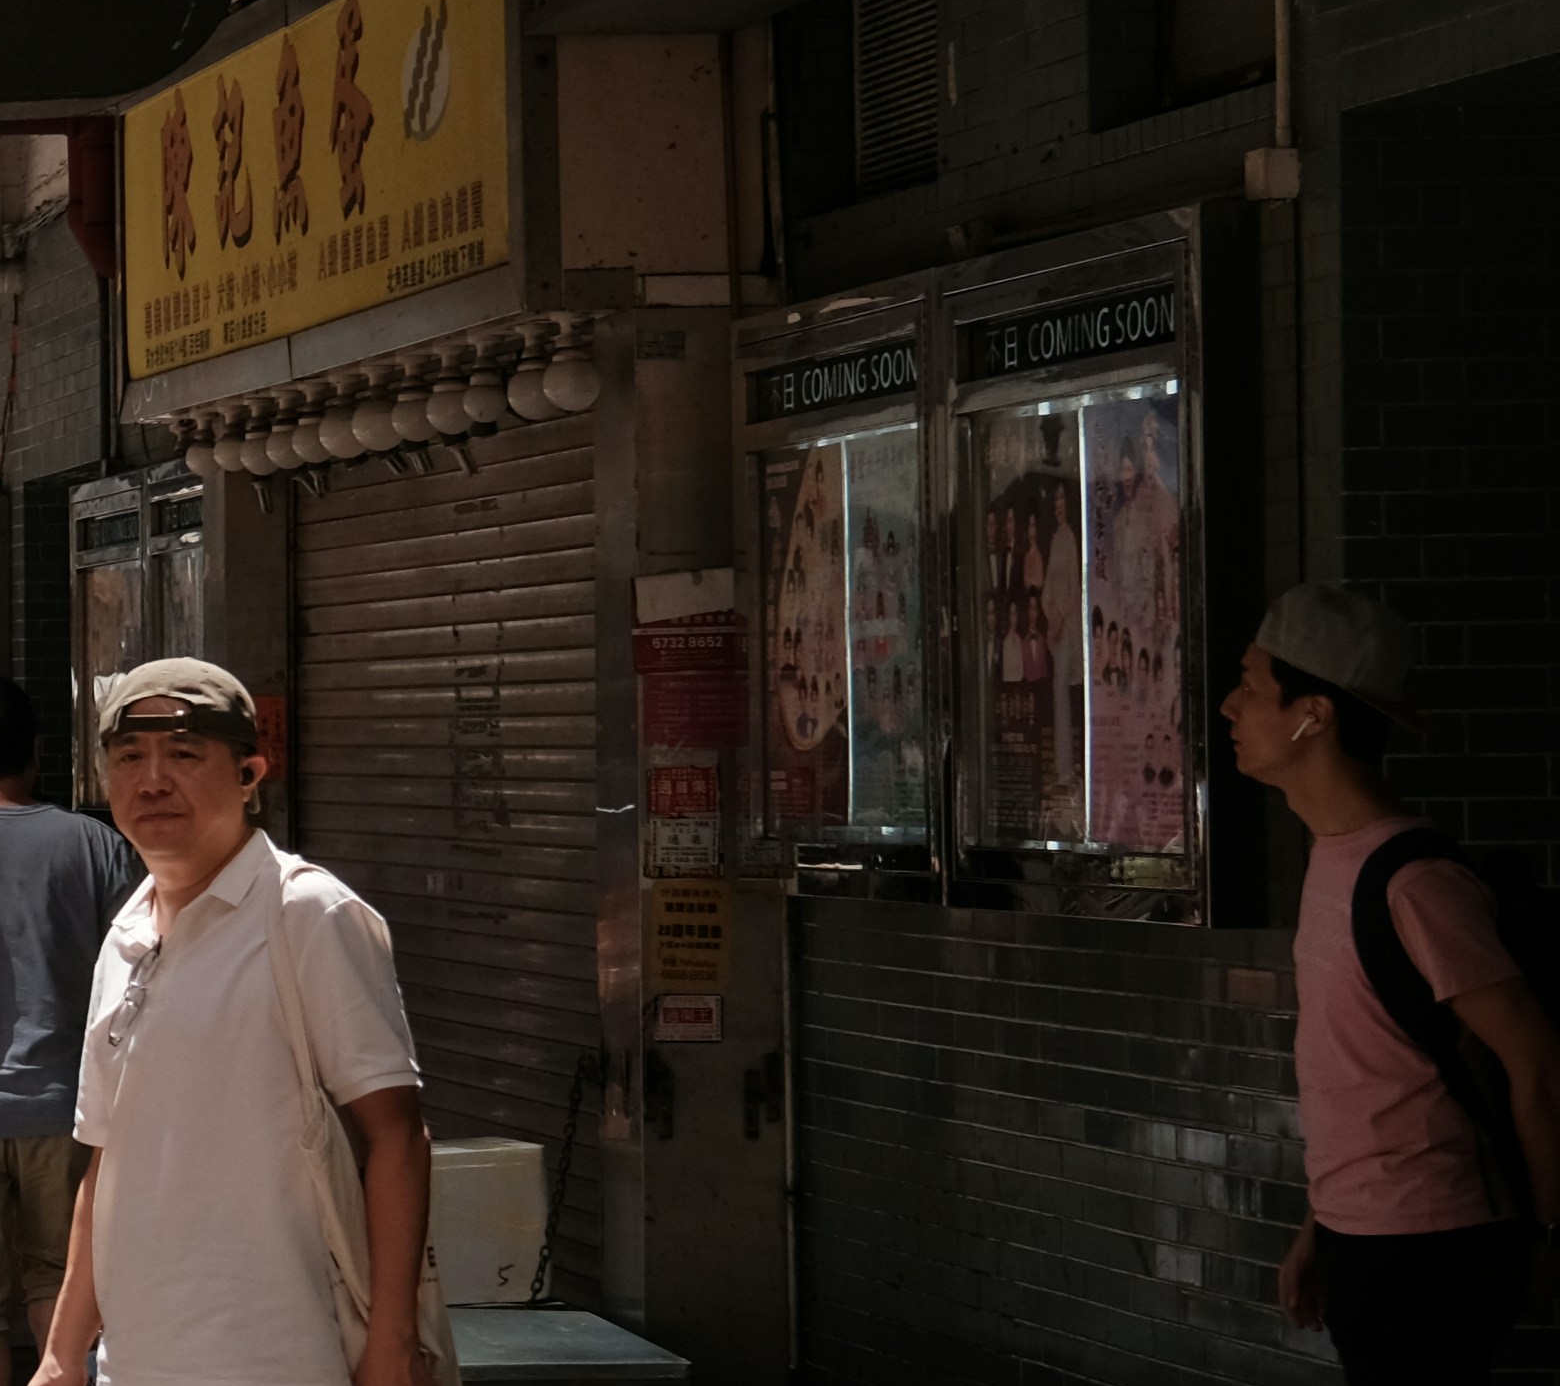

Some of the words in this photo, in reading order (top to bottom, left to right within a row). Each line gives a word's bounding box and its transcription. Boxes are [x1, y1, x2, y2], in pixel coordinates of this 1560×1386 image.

[1027, 306, 1111, 363] COMING
[1114, 292, 1176, 346] SOON
[801, 357, 867, 406] COMING
[870, 346, 918, 392] SOON
[651, 637, 686, 649] 6732
[688, 635, 724, 648] 8652
